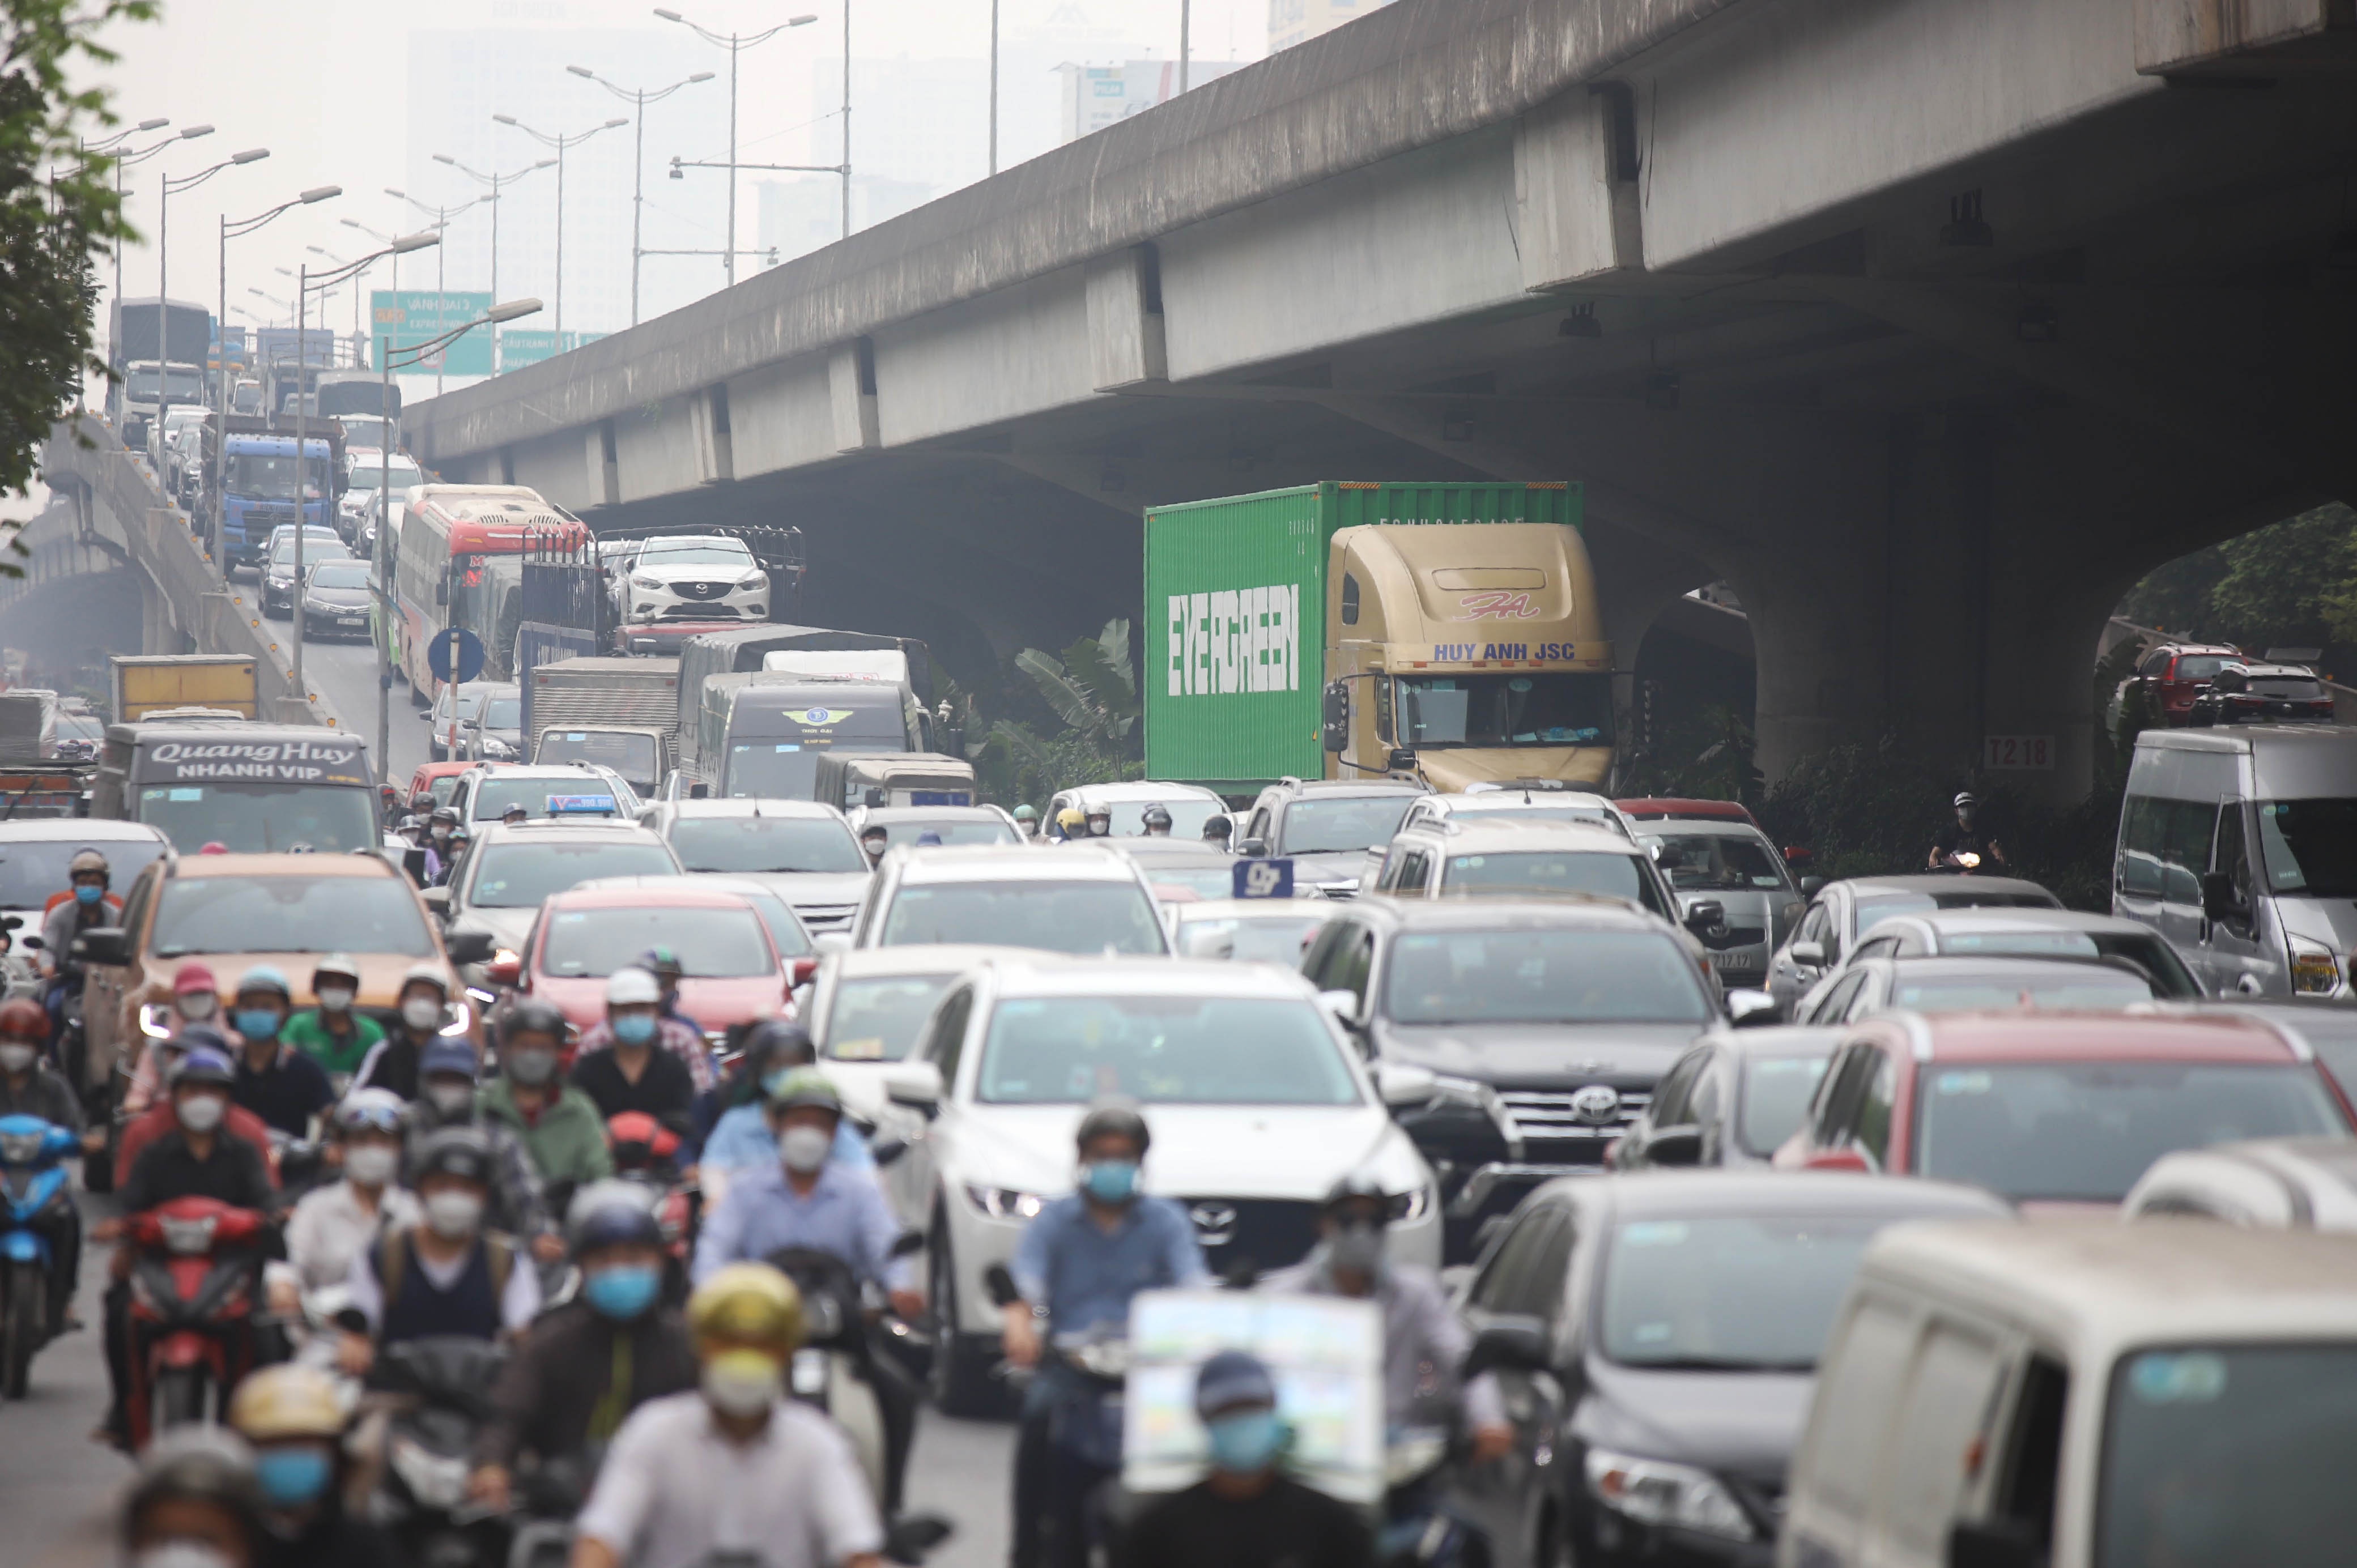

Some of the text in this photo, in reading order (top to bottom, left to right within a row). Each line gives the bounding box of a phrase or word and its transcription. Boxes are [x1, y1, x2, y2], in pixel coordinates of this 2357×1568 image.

[1168, 583, 1299, 696] EVERGREEN
[1434, 643, 1575, 661] HUY ANH JSC
[151, 742, 355, 765] Quang Huy
[1990, 739, 2047, 765] T218
[176, 764, 274, 778] NHANH
[278, 765, 323, 779] VIP
